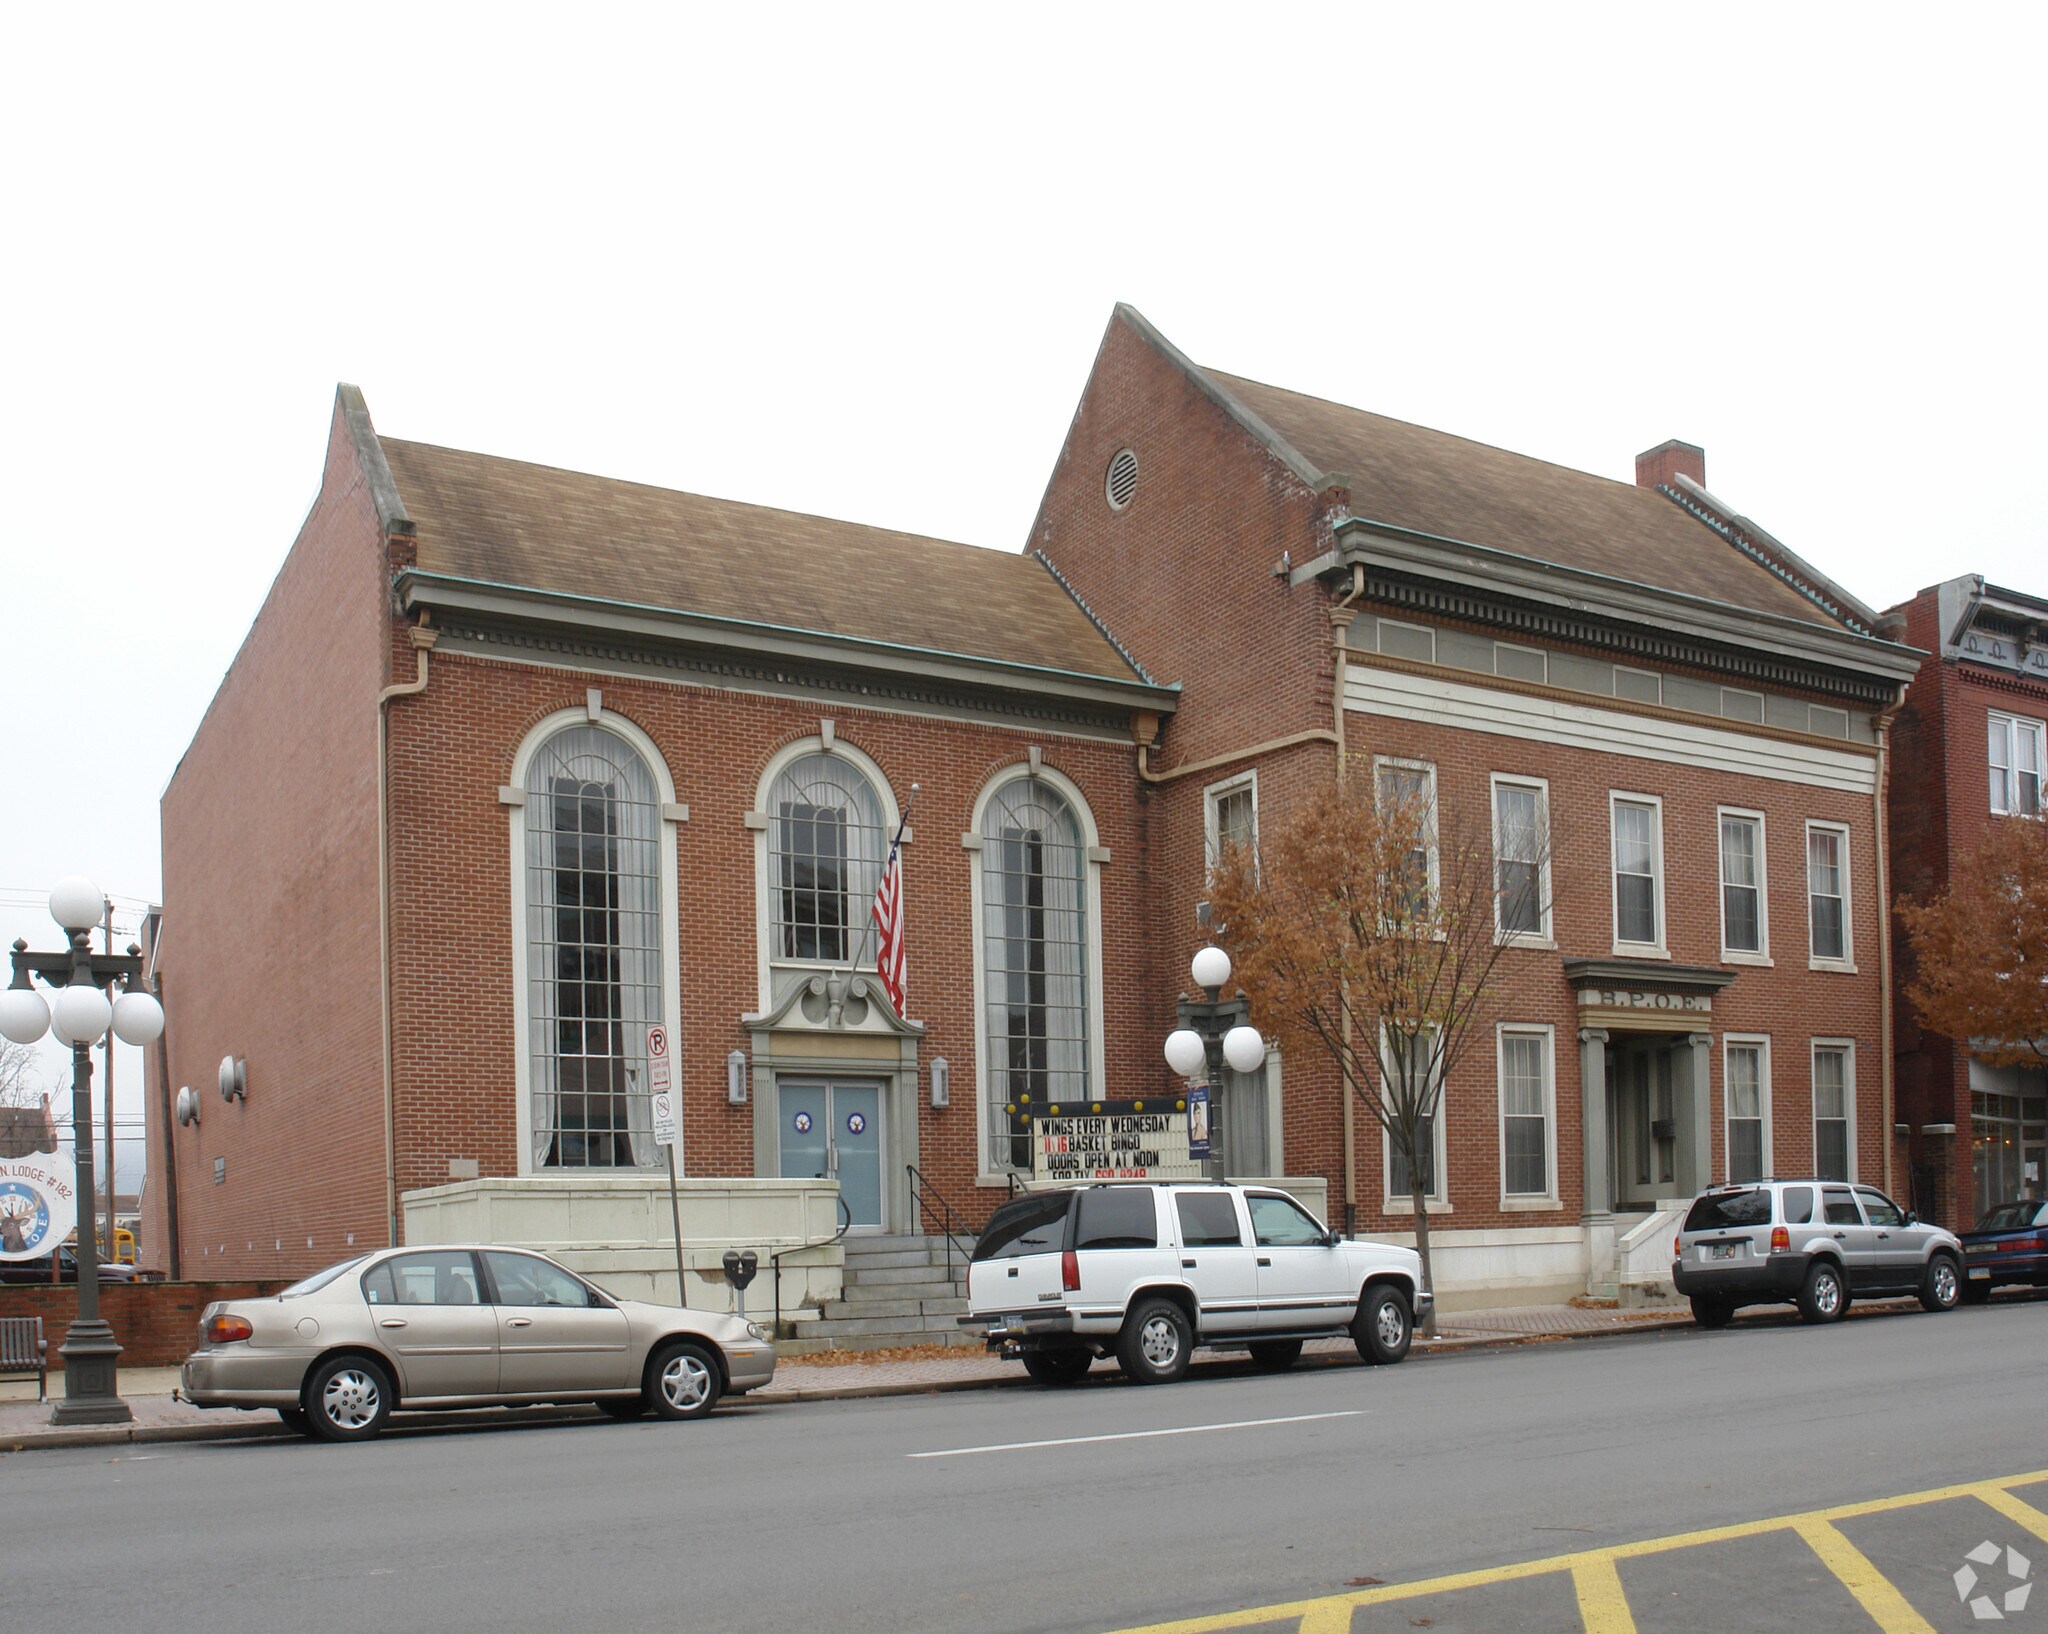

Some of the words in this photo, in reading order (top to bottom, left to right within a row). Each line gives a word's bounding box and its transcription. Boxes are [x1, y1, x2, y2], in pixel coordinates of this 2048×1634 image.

[1041, 1118, 1074, 1135] WINGS
[1077, 1117, 1107, 1135] EVERY
[1111, 1115, 1171, 1134] WEDNESDAY
[1068, 1135, 1106, 1152] BASKET
[1111, 1134, 1140, 1150] BINGO
[1047, 1153, 1079, 1169] DOORS
[1085, 1152, 1110, 1168] OPEN
[1115, 1152, 1128, 1168] AT
[1133, 1151, 1159, 1167] NOON
[12, 1165, 45, 1182] LODGE
[47, 1176, 73, 1200] #182
